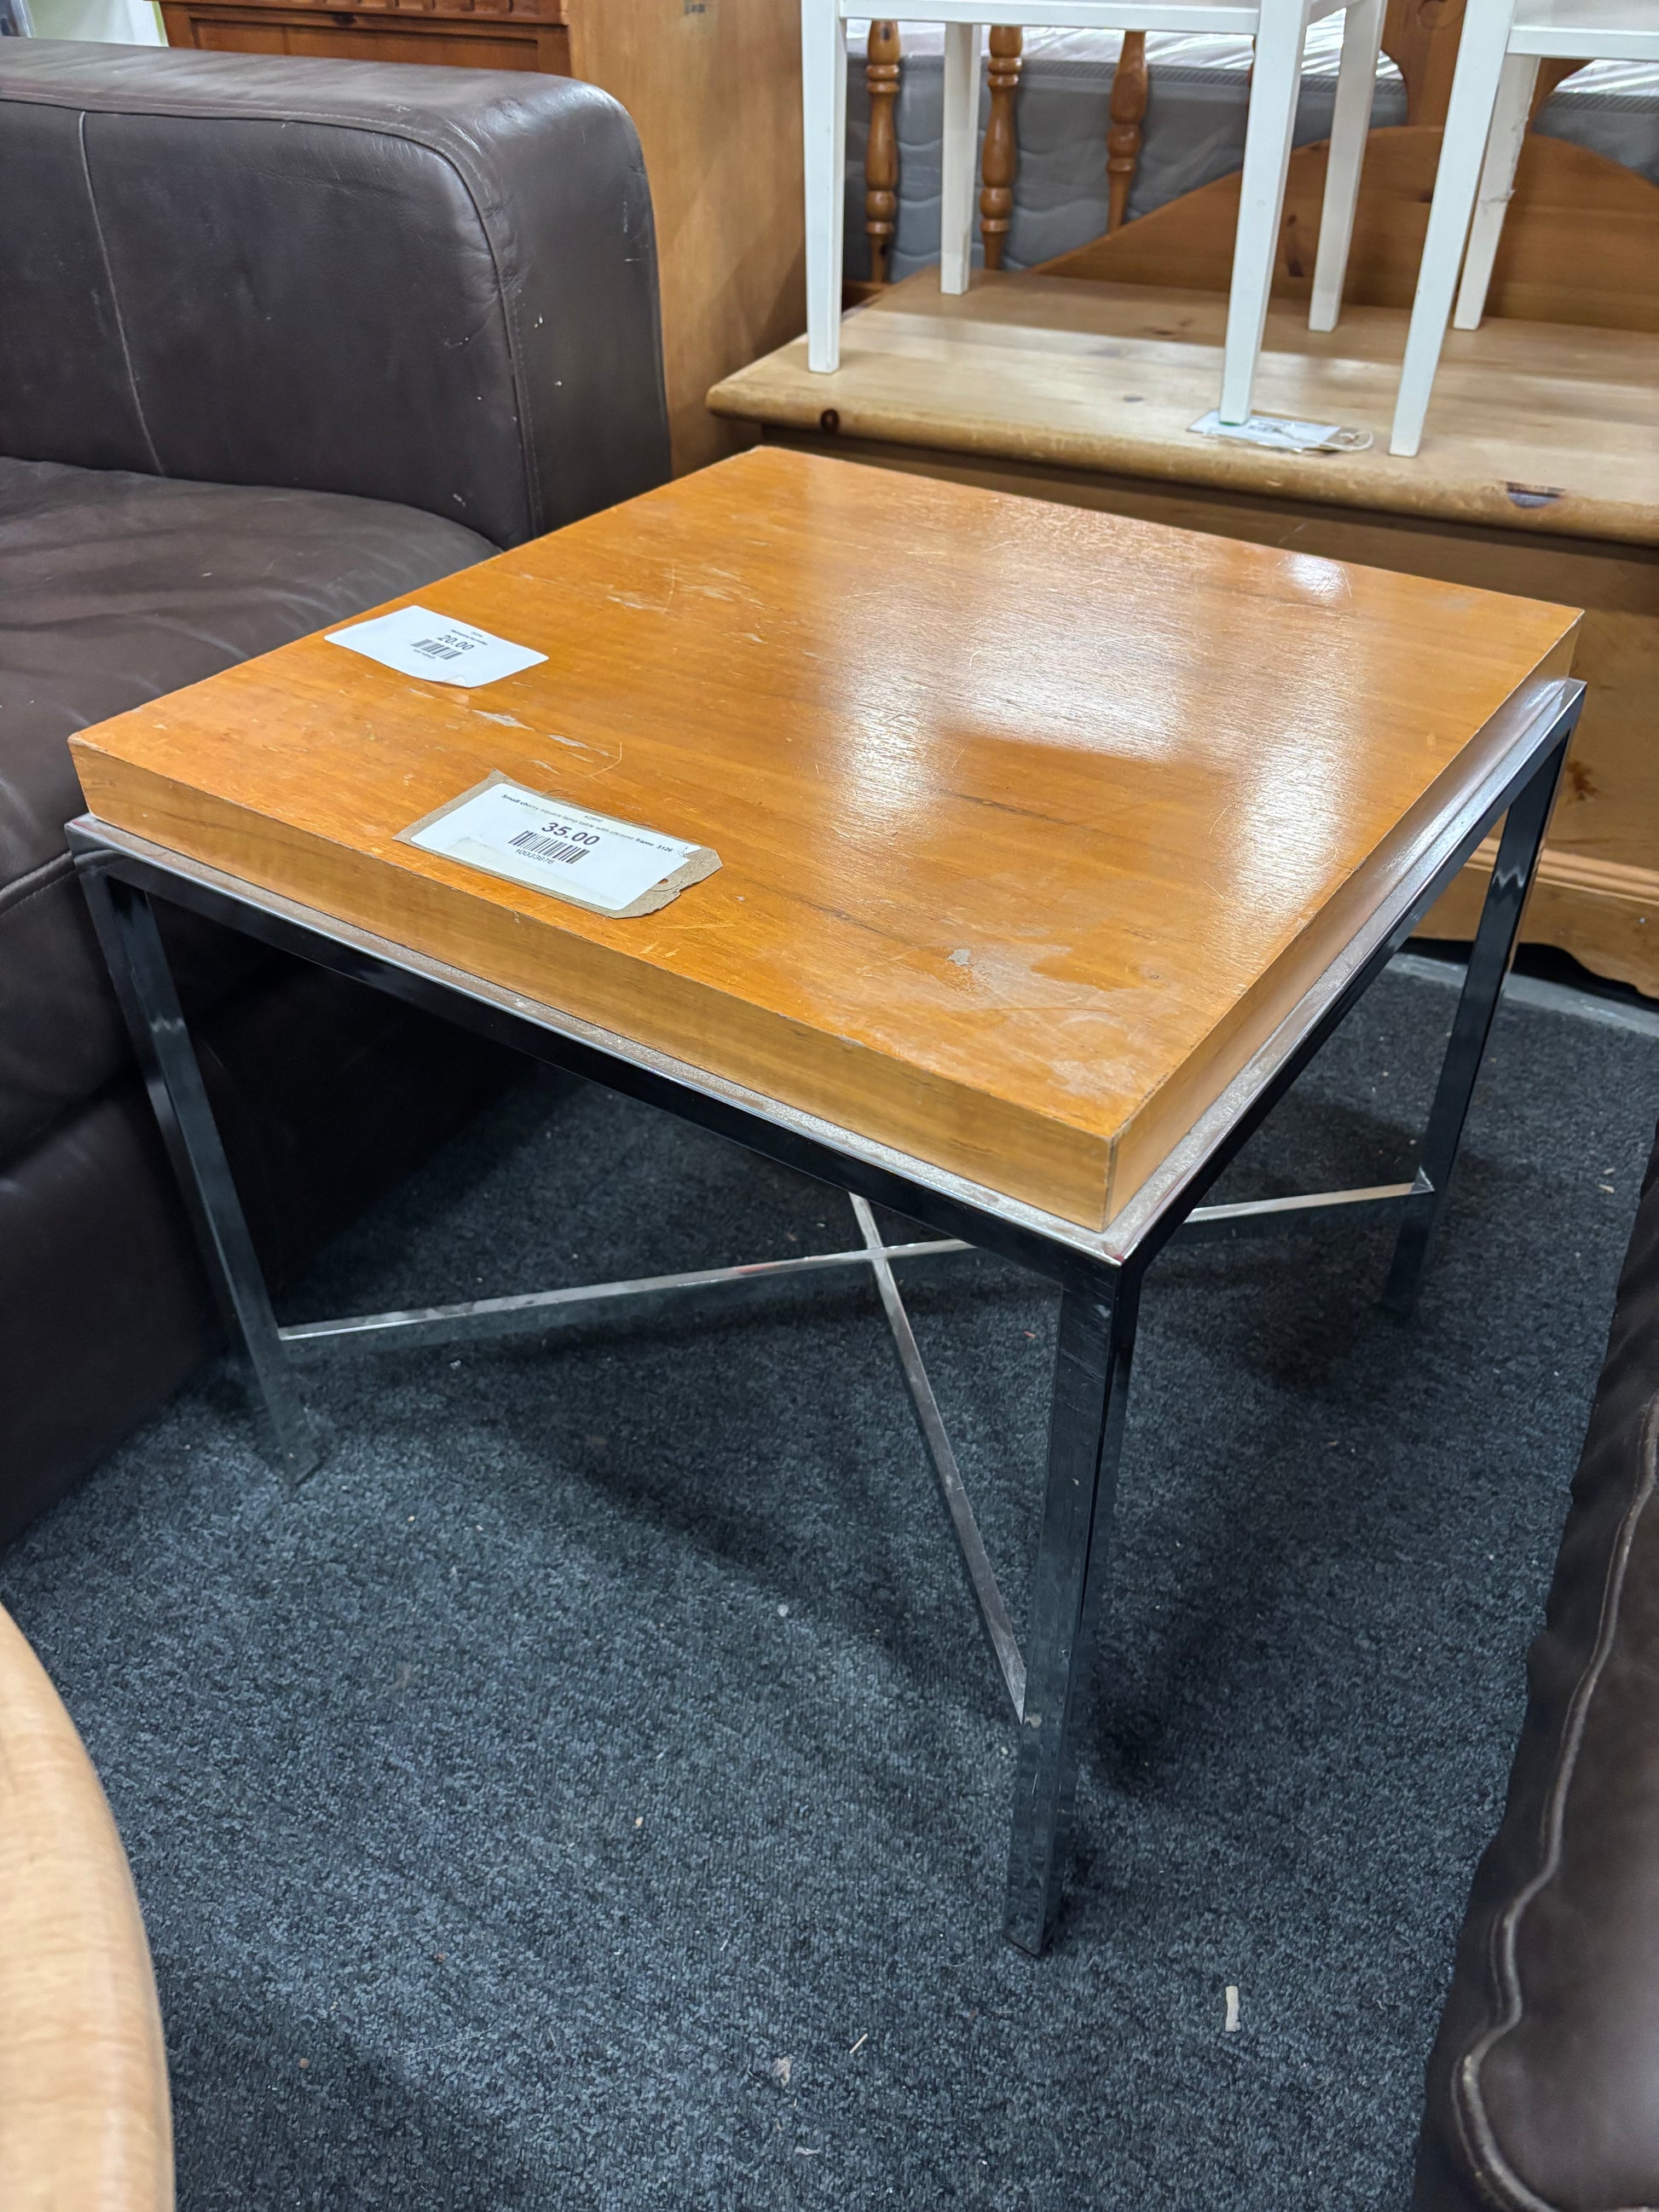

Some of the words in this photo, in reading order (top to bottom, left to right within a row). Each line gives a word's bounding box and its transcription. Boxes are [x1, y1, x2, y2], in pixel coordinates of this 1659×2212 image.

[436, 634, 475, 650] 20.00
[501, 794, 521, 803] Small
[635, 838, 654, 846] frame
[541, 822, 600, 846] 35.00
